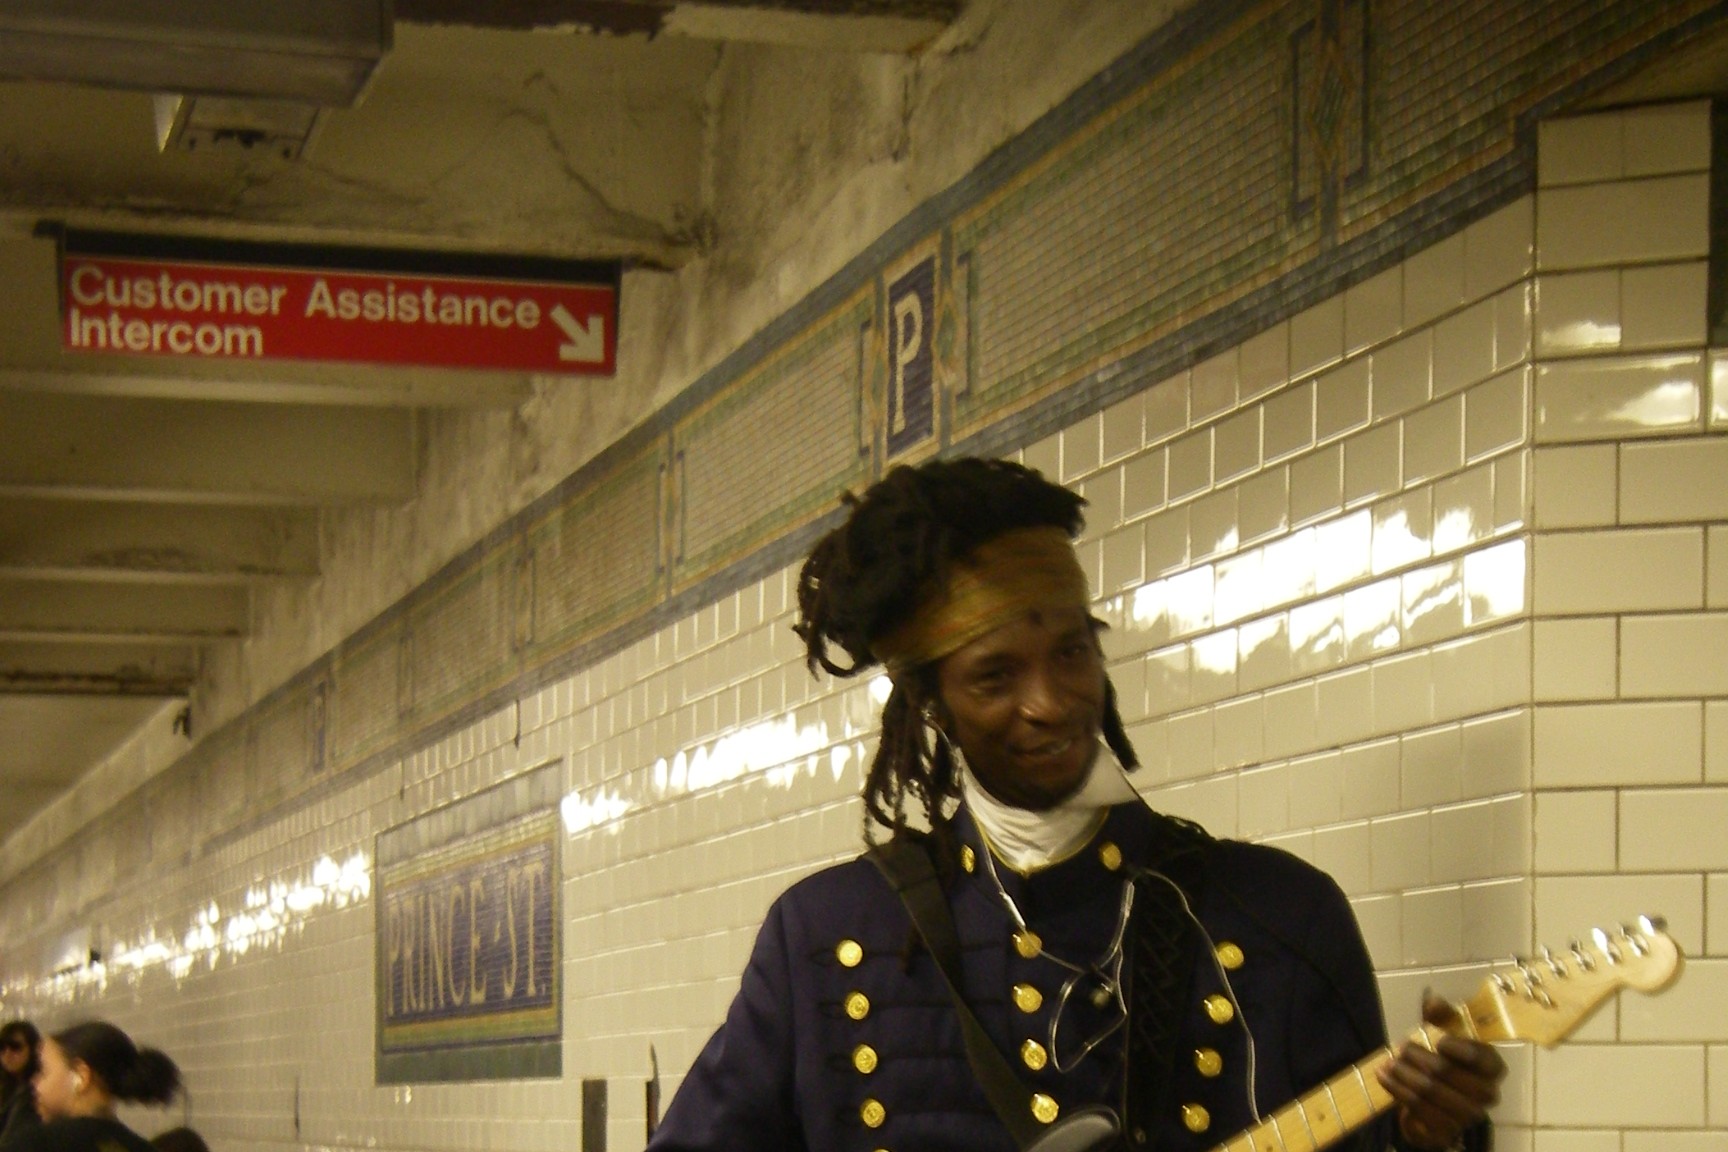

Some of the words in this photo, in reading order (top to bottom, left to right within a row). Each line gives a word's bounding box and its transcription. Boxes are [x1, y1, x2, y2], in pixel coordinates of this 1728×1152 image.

[70, 307, 264, 356] Intercom
[71, 264, 287, 316] Customer
[304, 278, 541, 329] Assistance
[893, 291, 923, 435] P
[387, 877, 488, 1017] PRINCE
